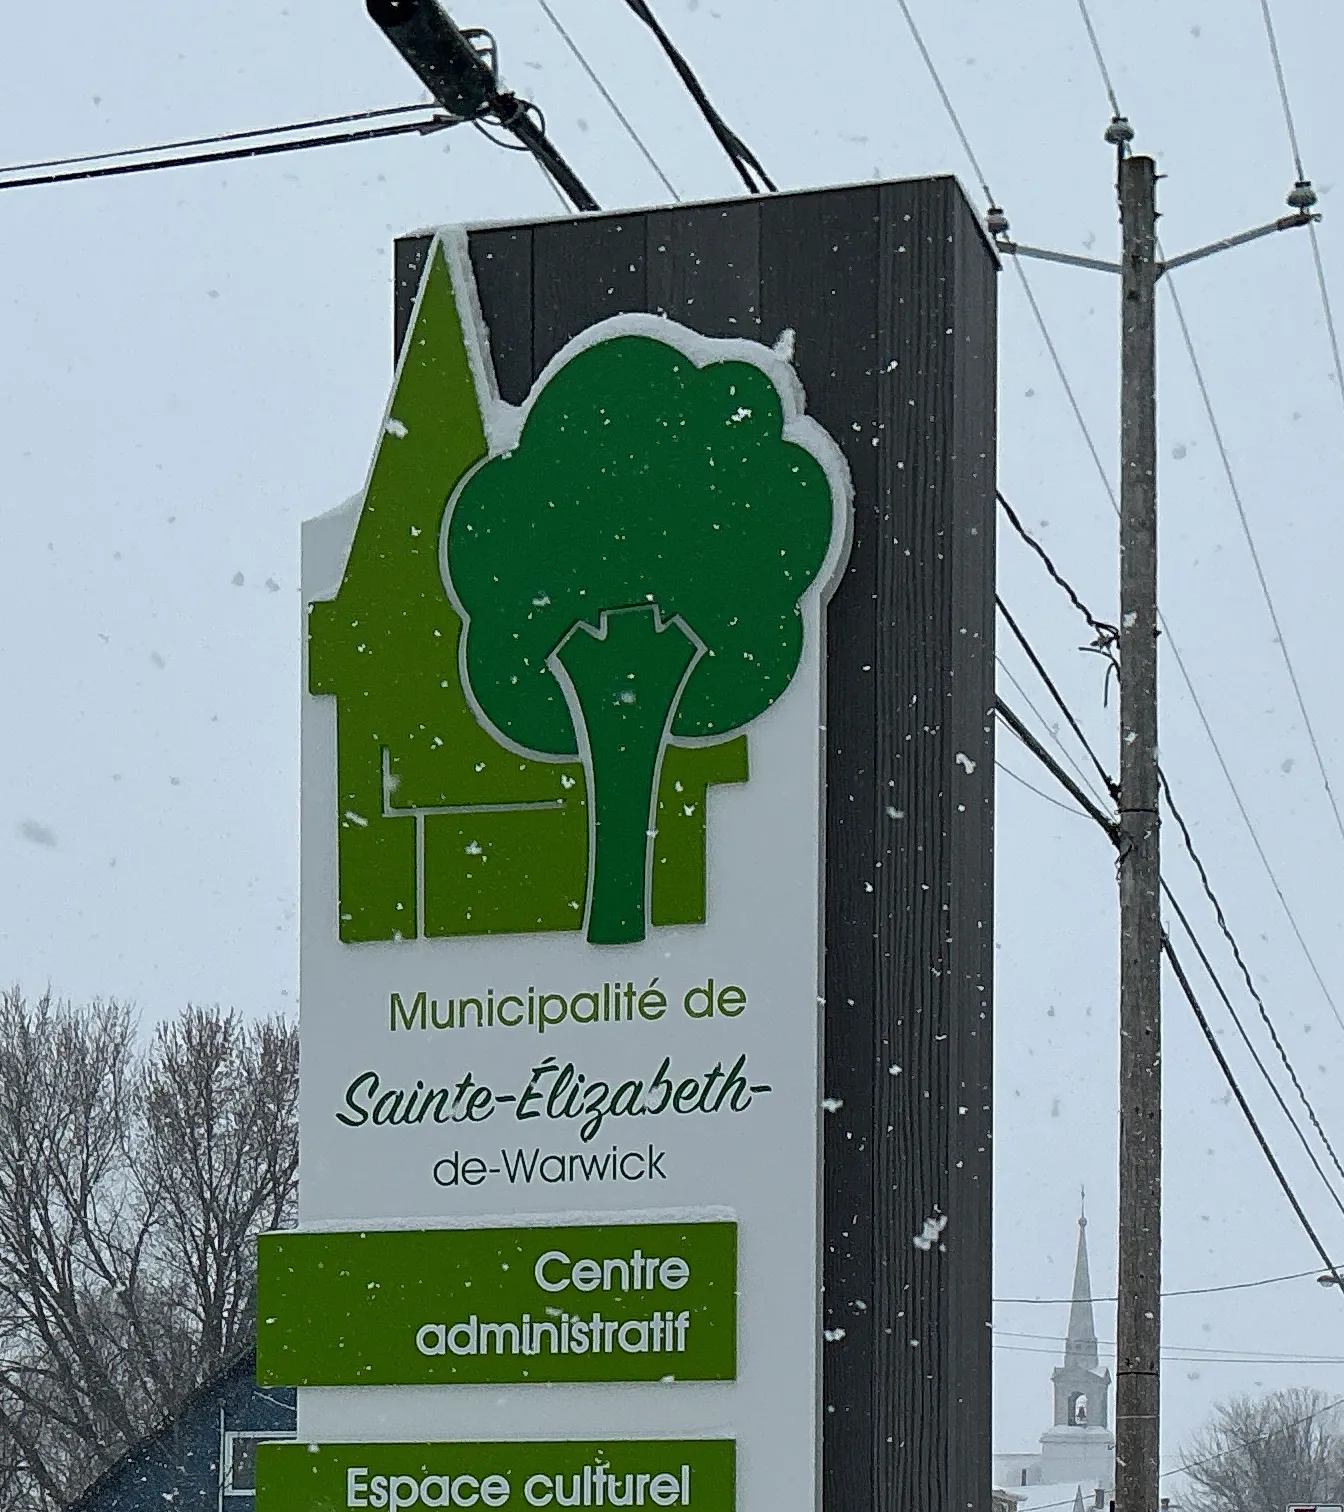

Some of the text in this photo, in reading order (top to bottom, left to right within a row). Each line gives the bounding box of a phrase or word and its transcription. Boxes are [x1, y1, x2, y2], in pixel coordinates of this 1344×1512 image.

[388, 977, 748, 1033] Municipalité de
[335, 1053, 773, 1142] Sainte-Élizabeth-
[432, 1144, 667, 1187] de-Warwick
[533, 1249, 691, 1293] Centre
[415, 1310, 691, 1356] administratif
[523, 1464, 691, 1507] culturel
